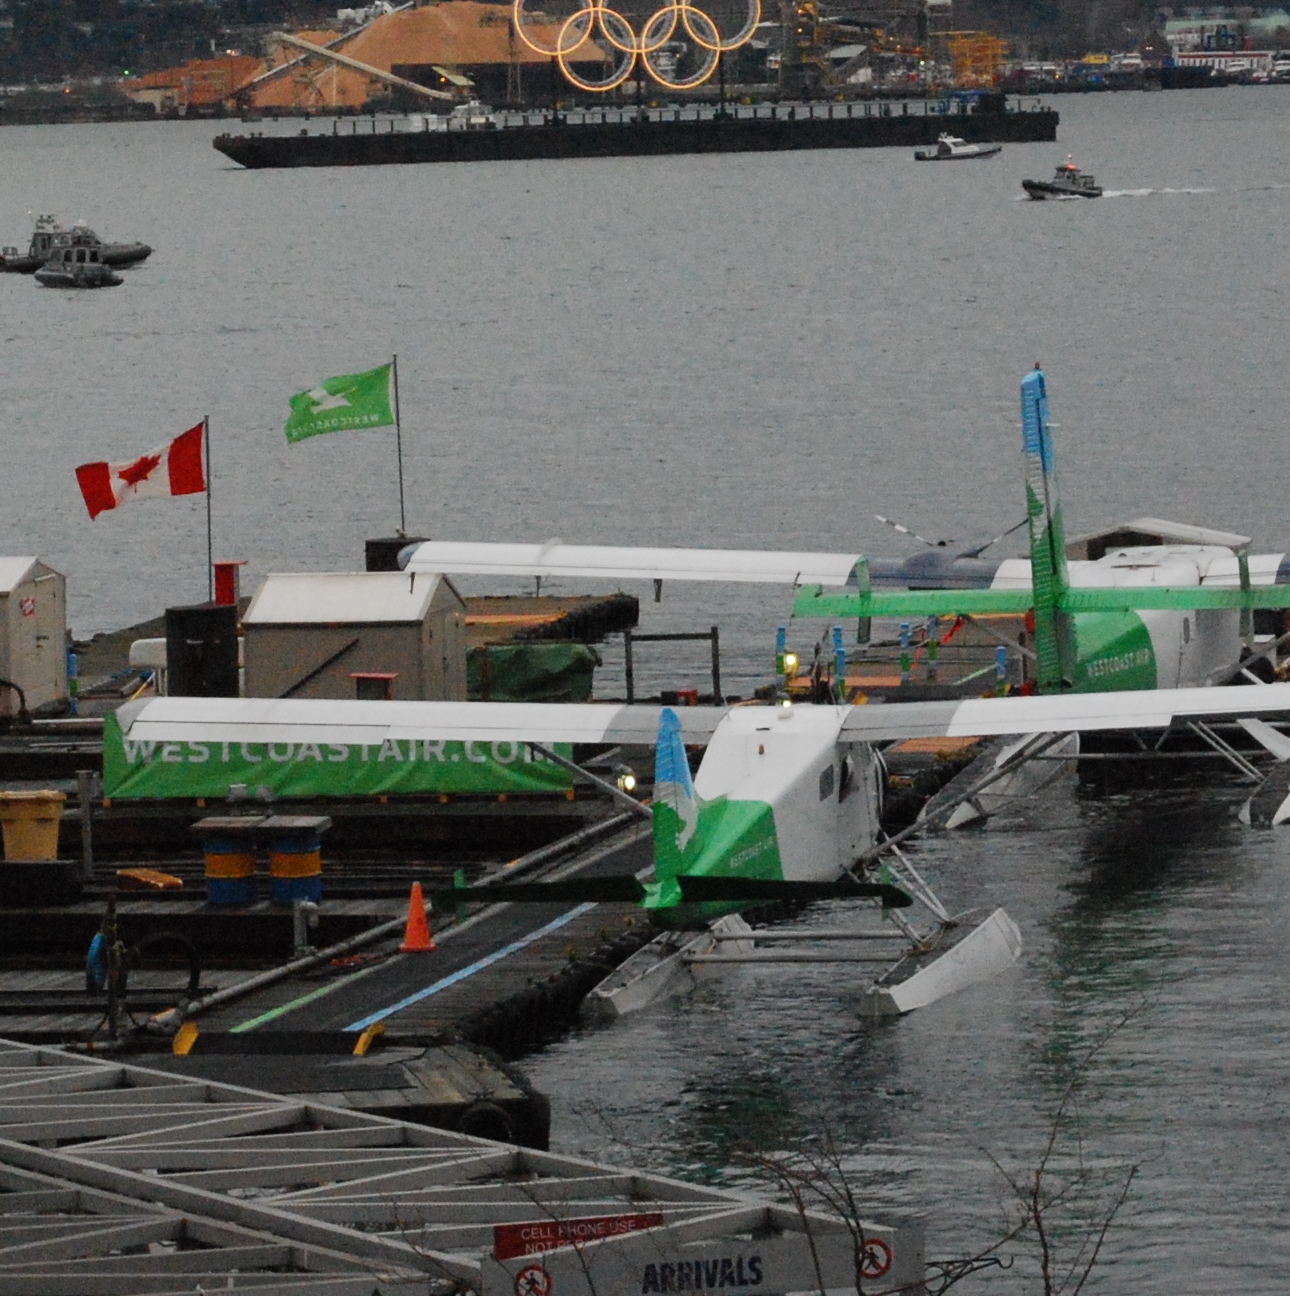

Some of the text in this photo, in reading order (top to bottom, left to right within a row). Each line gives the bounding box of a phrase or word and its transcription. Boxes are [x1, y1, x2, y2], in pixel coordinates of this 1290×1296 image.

[521, 1226, 555, 1240] CELL
[609, 1219, 637, 1234] USE
[642, 1255, 764, 1294] ARRIVALS
